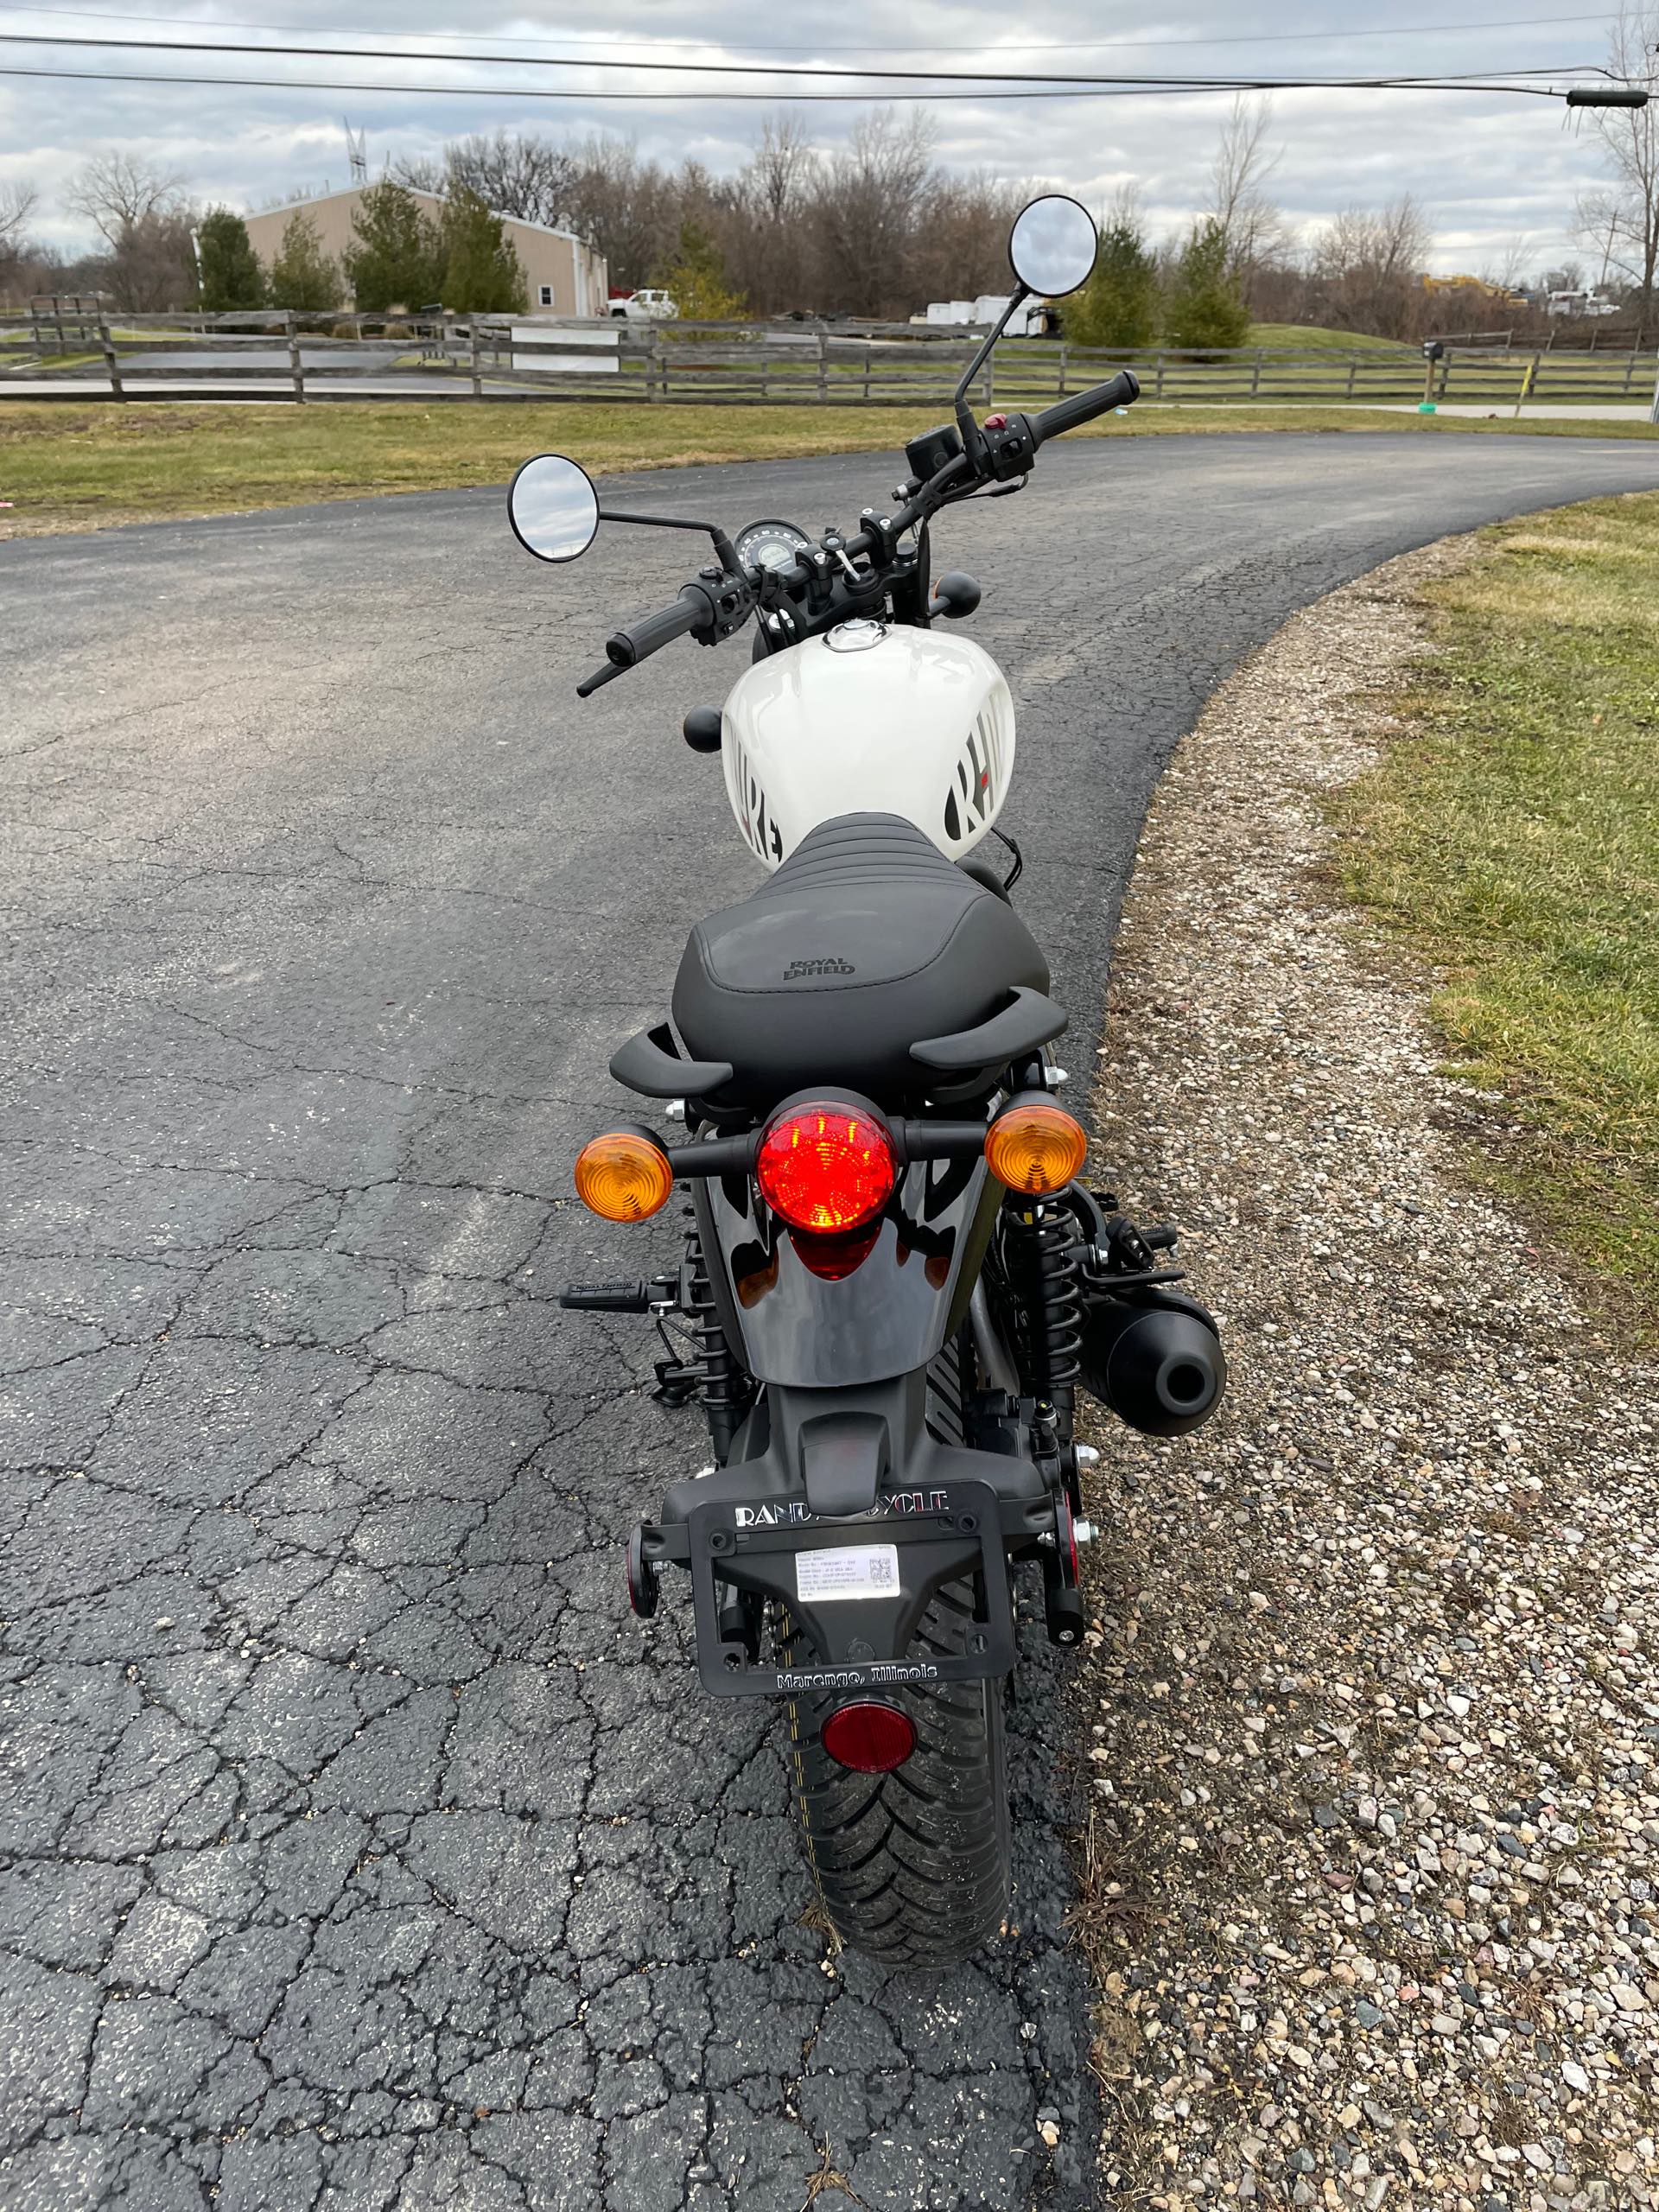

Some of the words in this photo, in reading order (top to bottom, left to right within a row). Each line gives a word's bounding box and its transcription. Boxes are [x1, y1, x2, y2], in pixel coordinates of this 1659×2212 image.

[783, 965, 855, 981] ENFIELD
[790, 957, 849, 969] ROYAL
[866, 1491, 950, 1517] YCLE
[777, 1672, 866, 1689] Marengo,
[870, 1663, 938, 1682] Illinois
